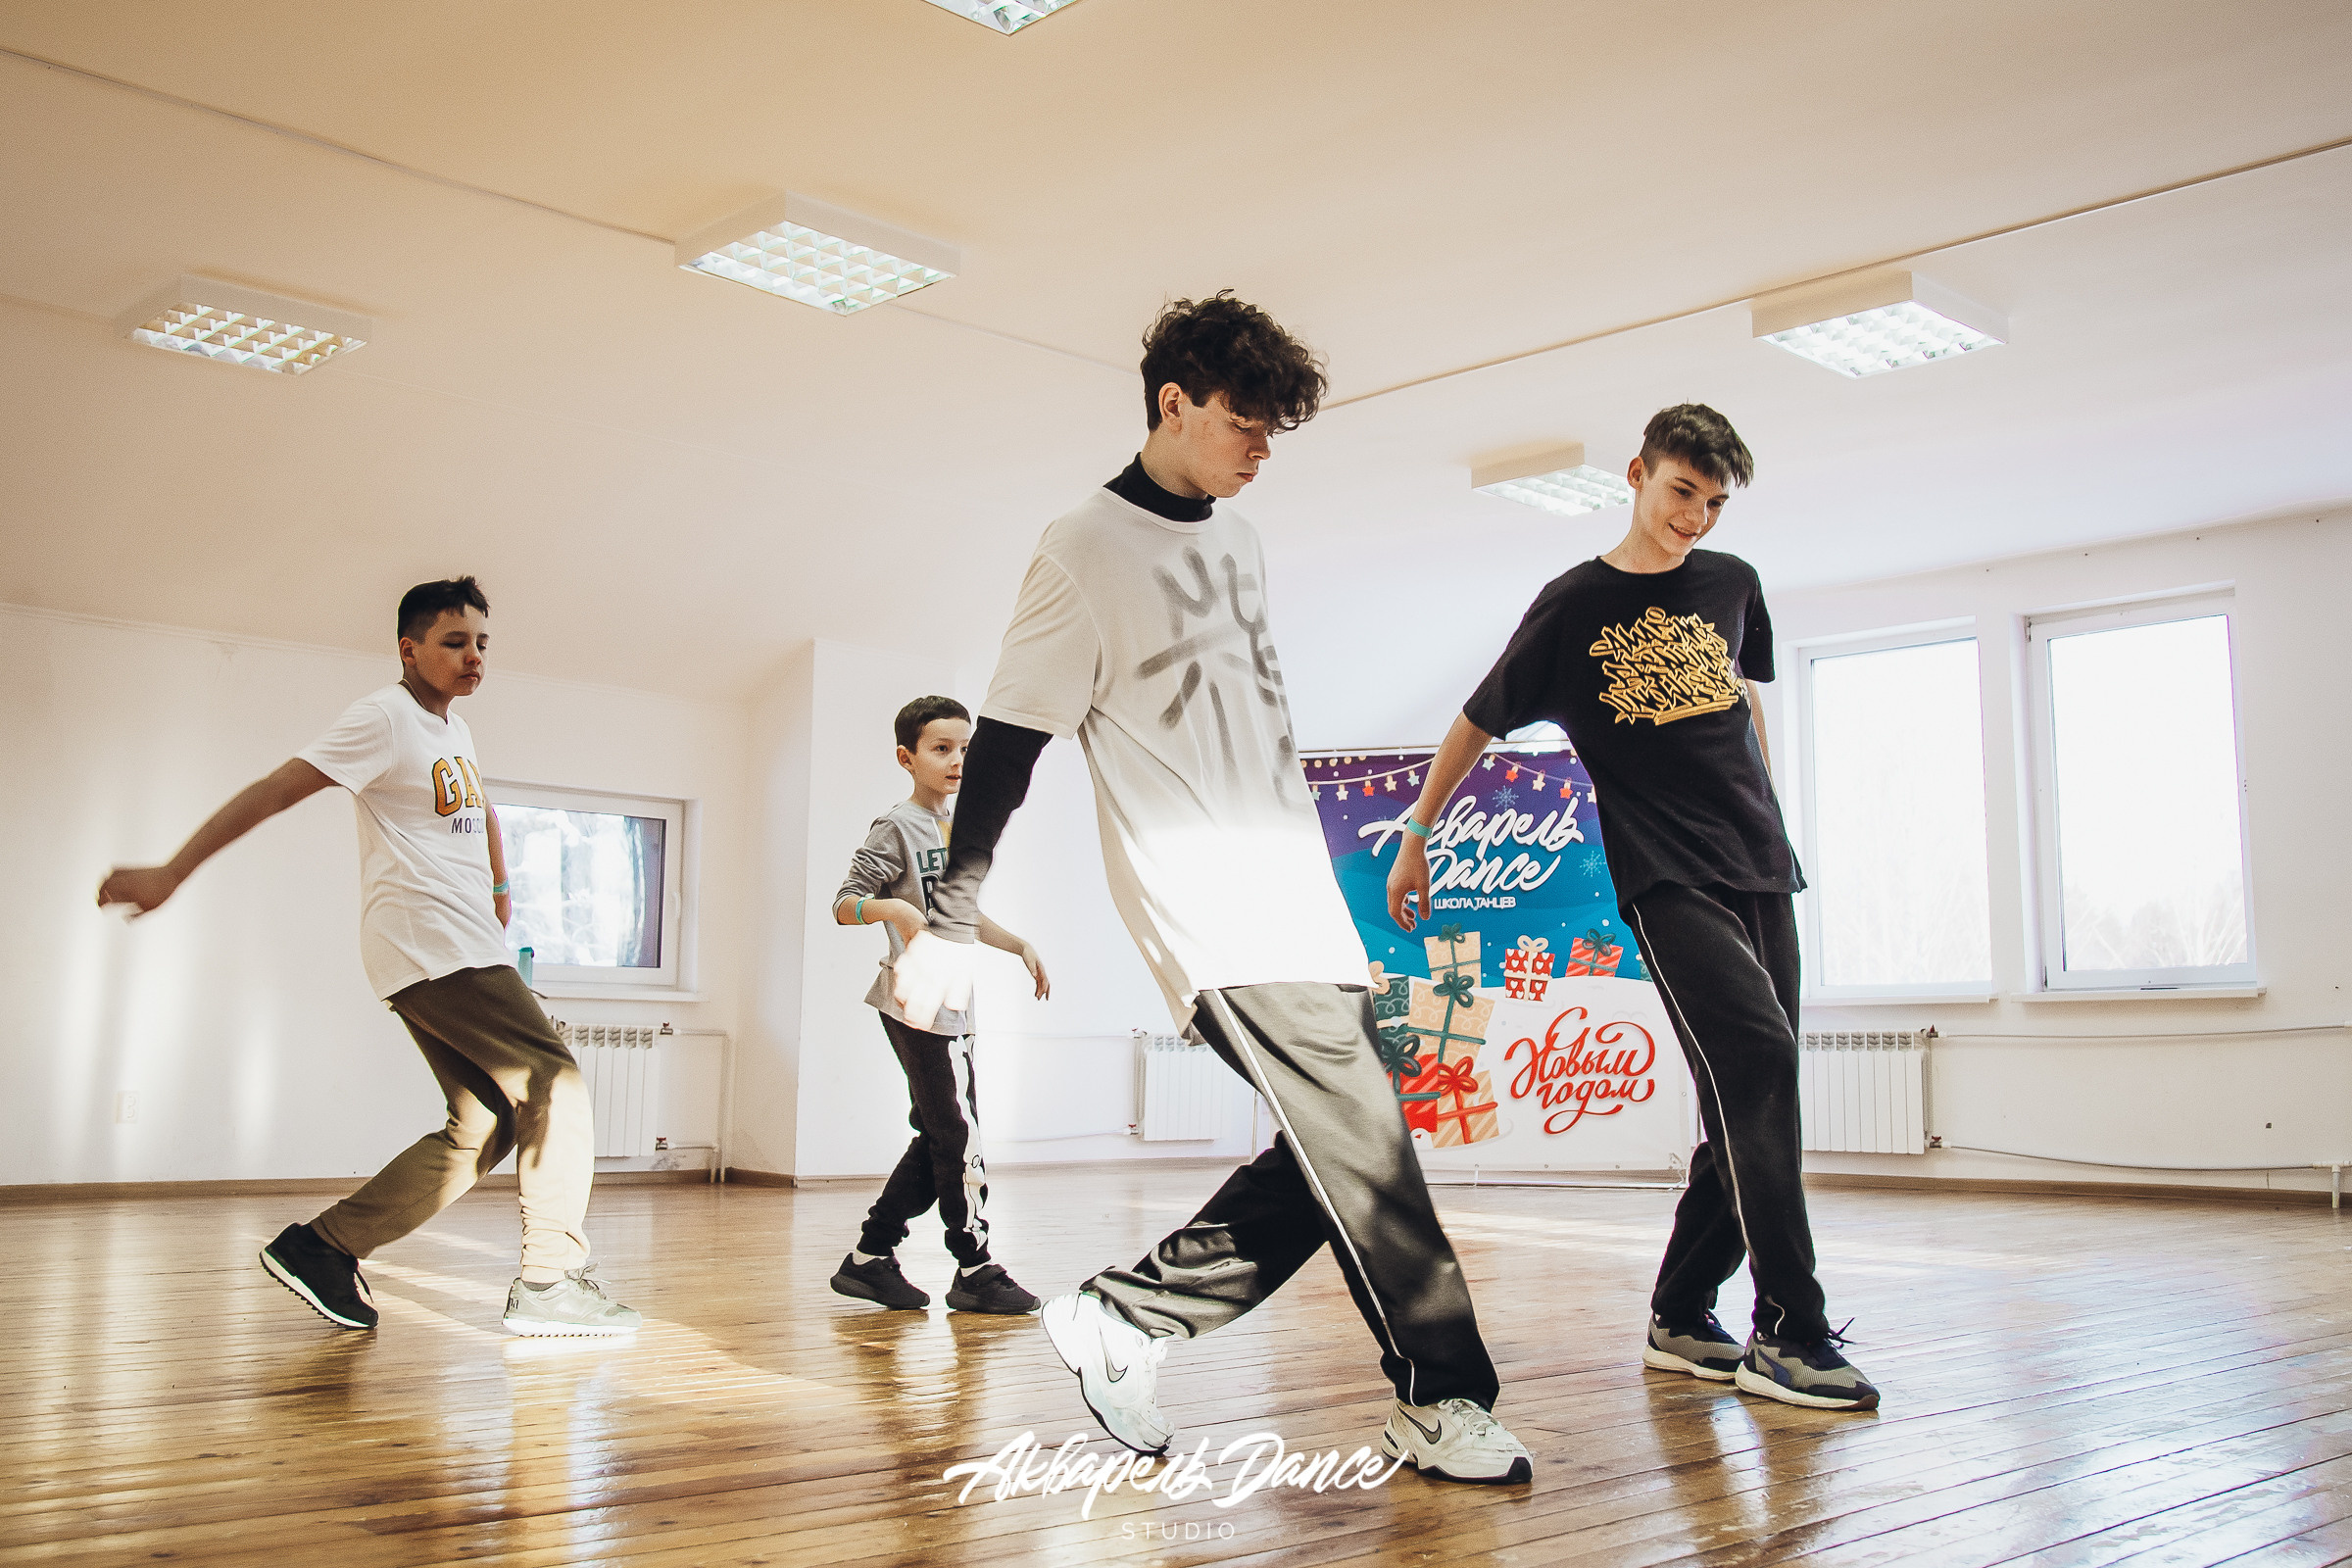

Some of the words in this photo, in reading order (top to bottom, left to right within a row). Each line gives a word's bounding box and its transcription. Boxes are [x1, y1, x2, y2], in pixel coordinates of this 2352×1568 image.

[432, 756, 486, 817] GA
[1434, 897, 1474, 909] ШКОЛА
[1473, 896, 1516, 909] ТАНЦЕВ
[1503, 1020, 1656, 1100] Новым
[1536, 1078, 1656, 1135] годом
